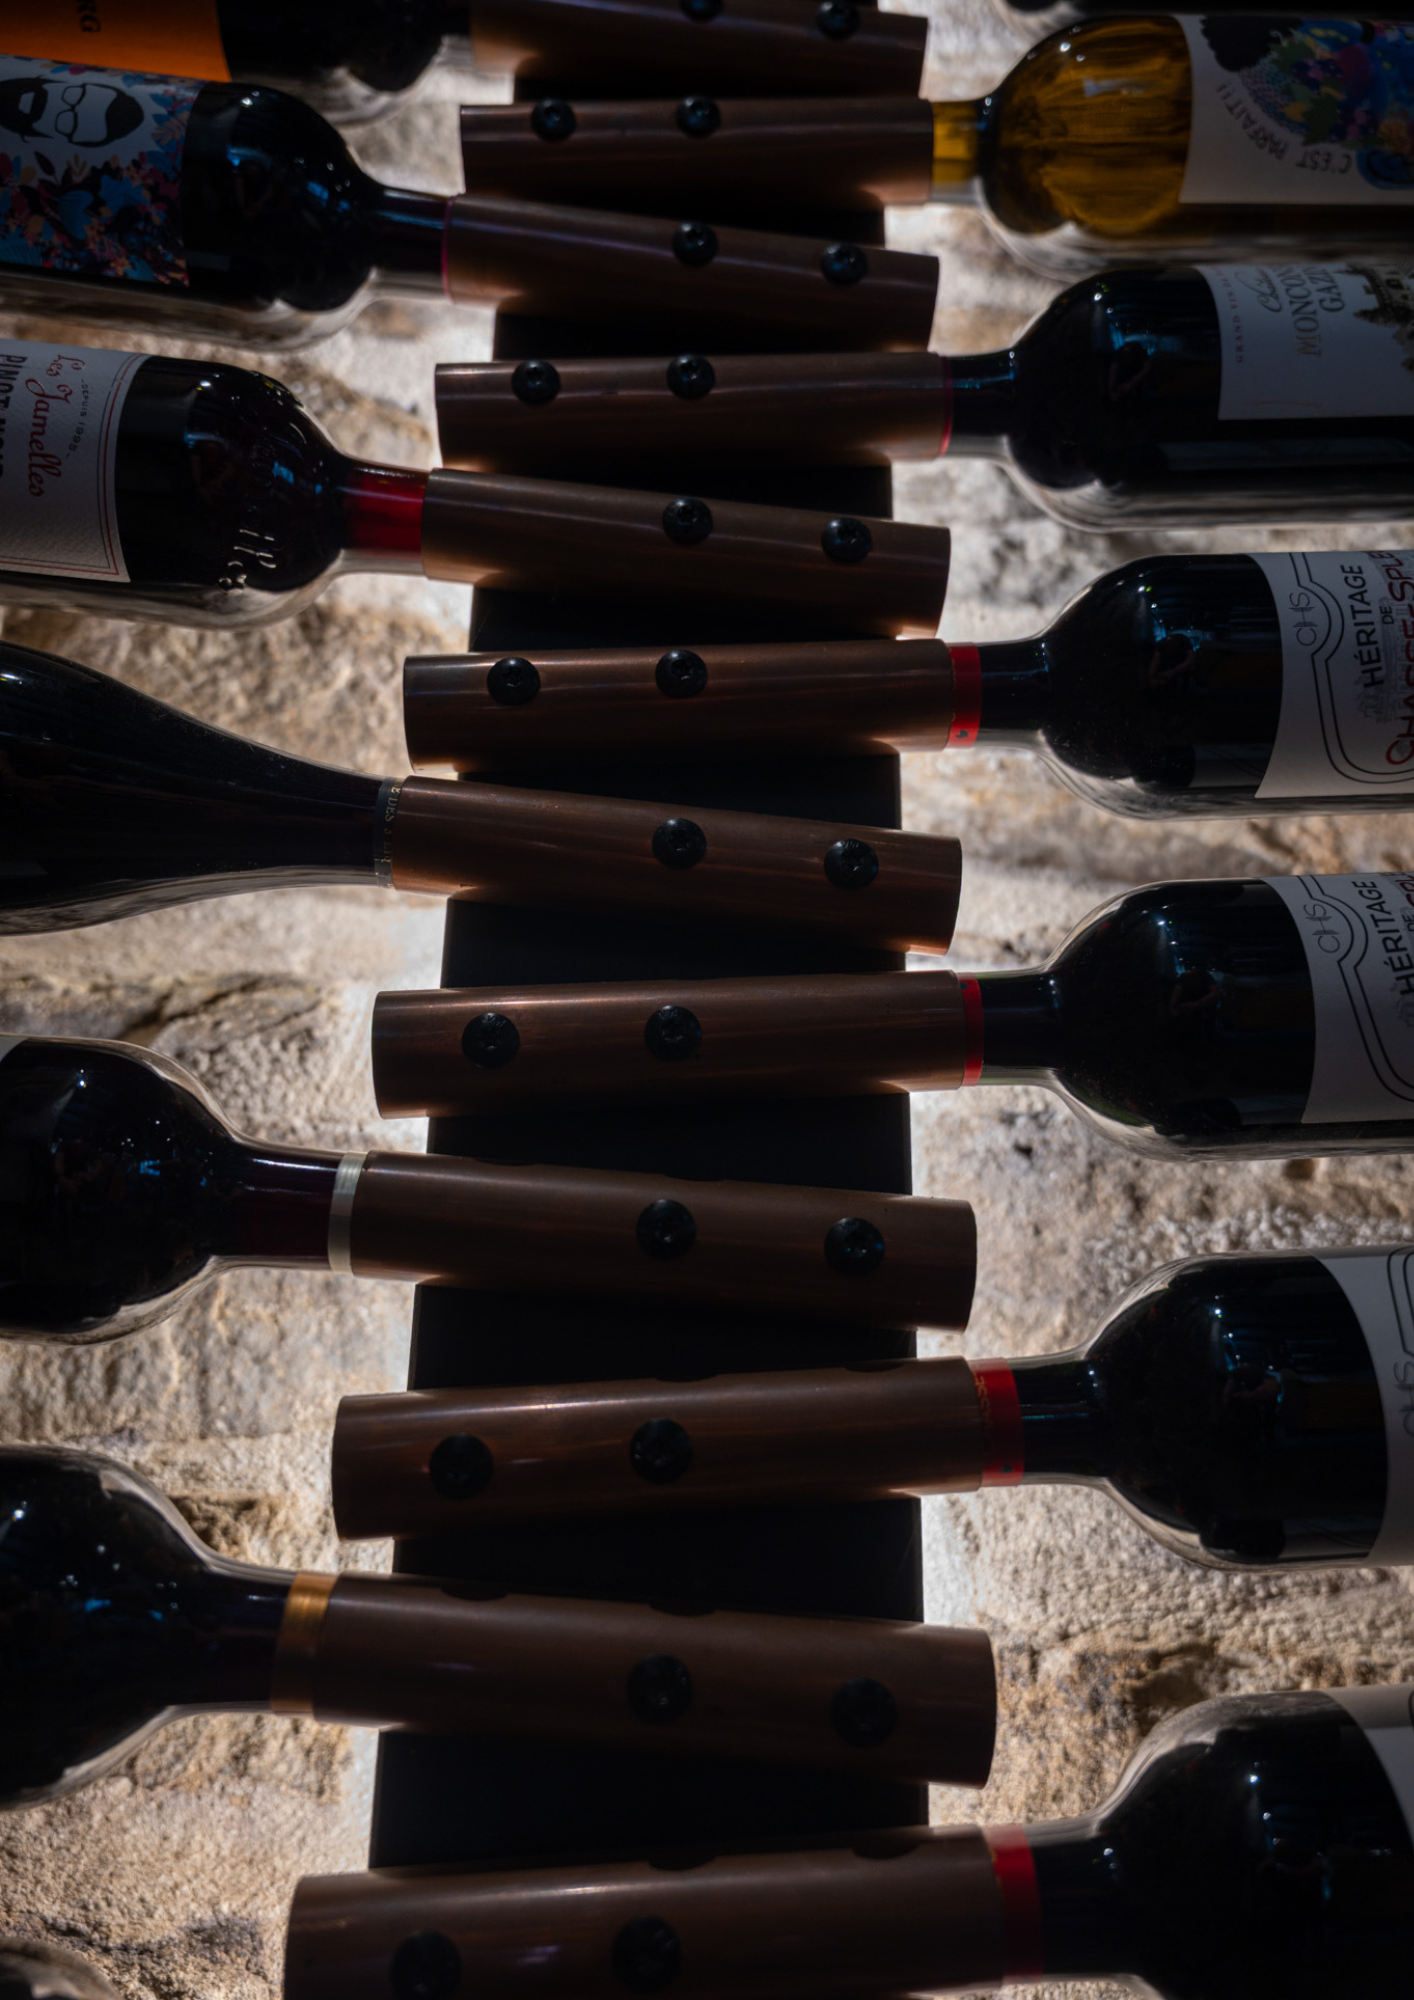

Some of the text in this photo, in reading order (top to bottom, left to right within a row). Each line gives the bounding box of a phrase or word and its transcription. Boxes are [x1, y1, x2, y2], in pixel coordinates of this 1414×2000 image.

[1296, 150, 1351, 174] C'EST
[1232, 315, 1243, 363] GRAND
[26, 353, 85, 497] Les Jamelles
[1340, 564, 1385, 688] HÉRITAGE
[1379, 606, 1394, 625] DE
[1352, 880, 1414, 995] HÉRITAGE
